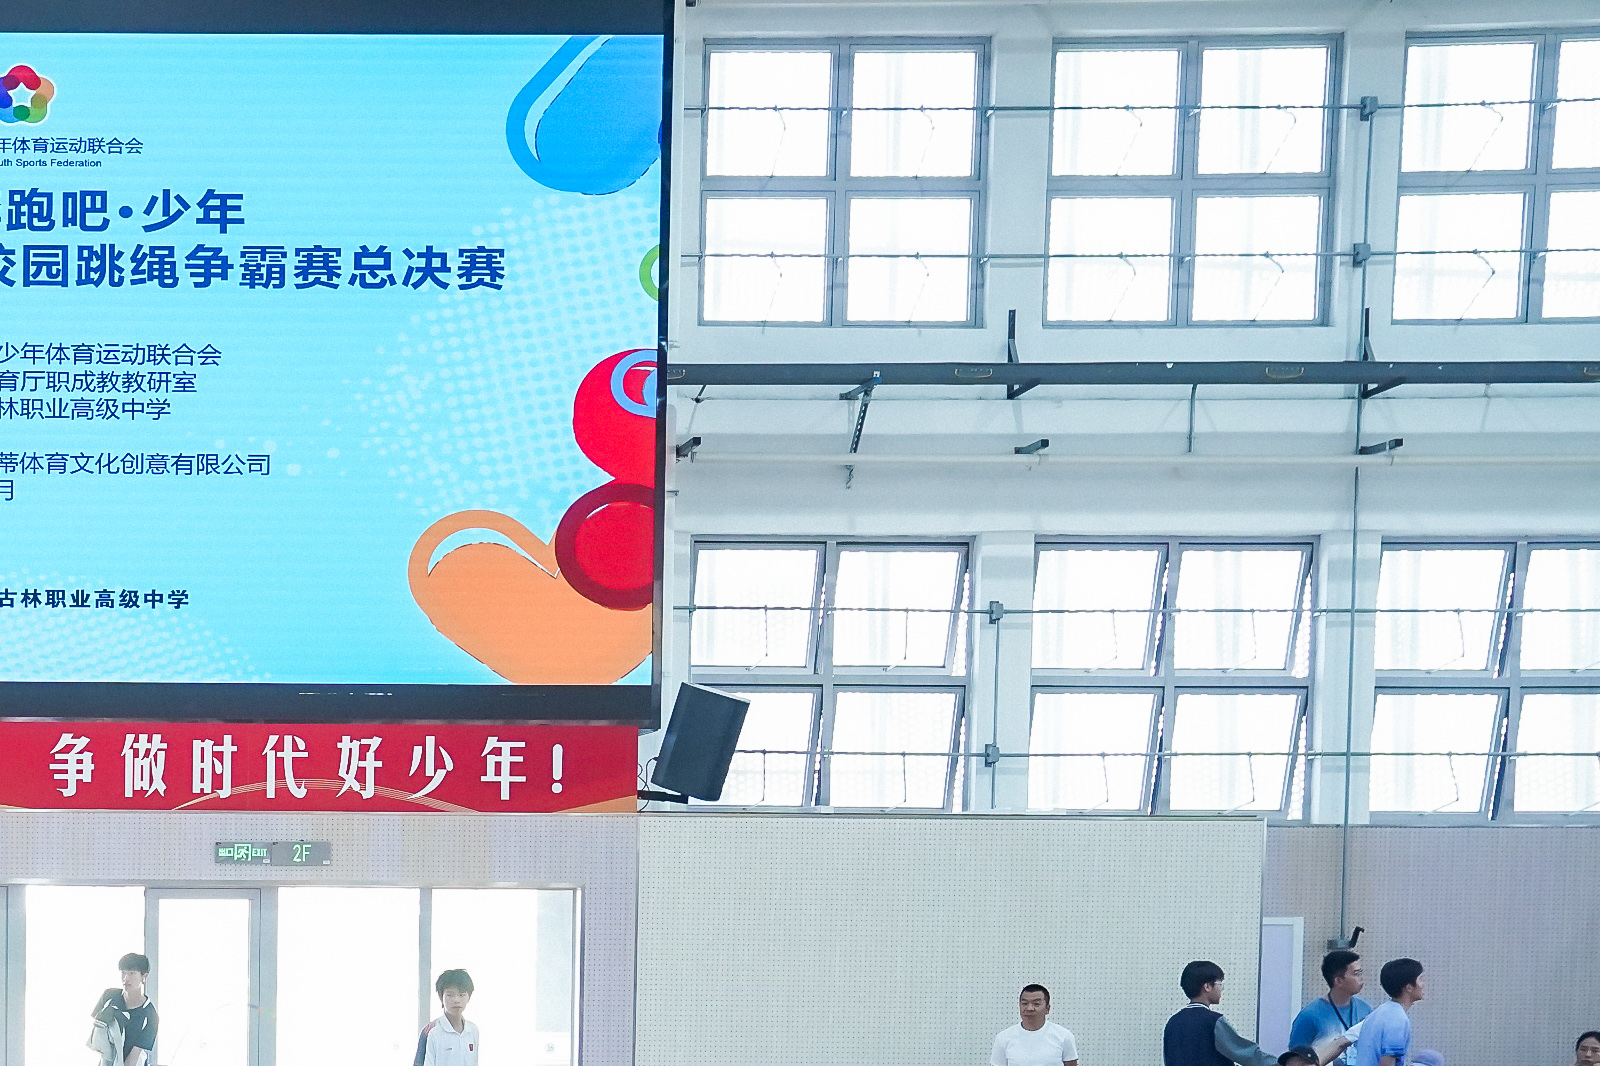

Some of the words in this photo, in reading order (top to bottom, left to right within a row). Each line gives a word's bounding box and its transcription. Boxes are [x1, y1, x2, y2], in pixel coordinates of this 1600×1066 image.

[16, 158, 47, 168] Sports
[50, 158, 102, 168] Federation
[218, 847, 234, 857] 出口
[252, 848, 268, 857] EXIT
[292, 843, 312, 862] 2F
